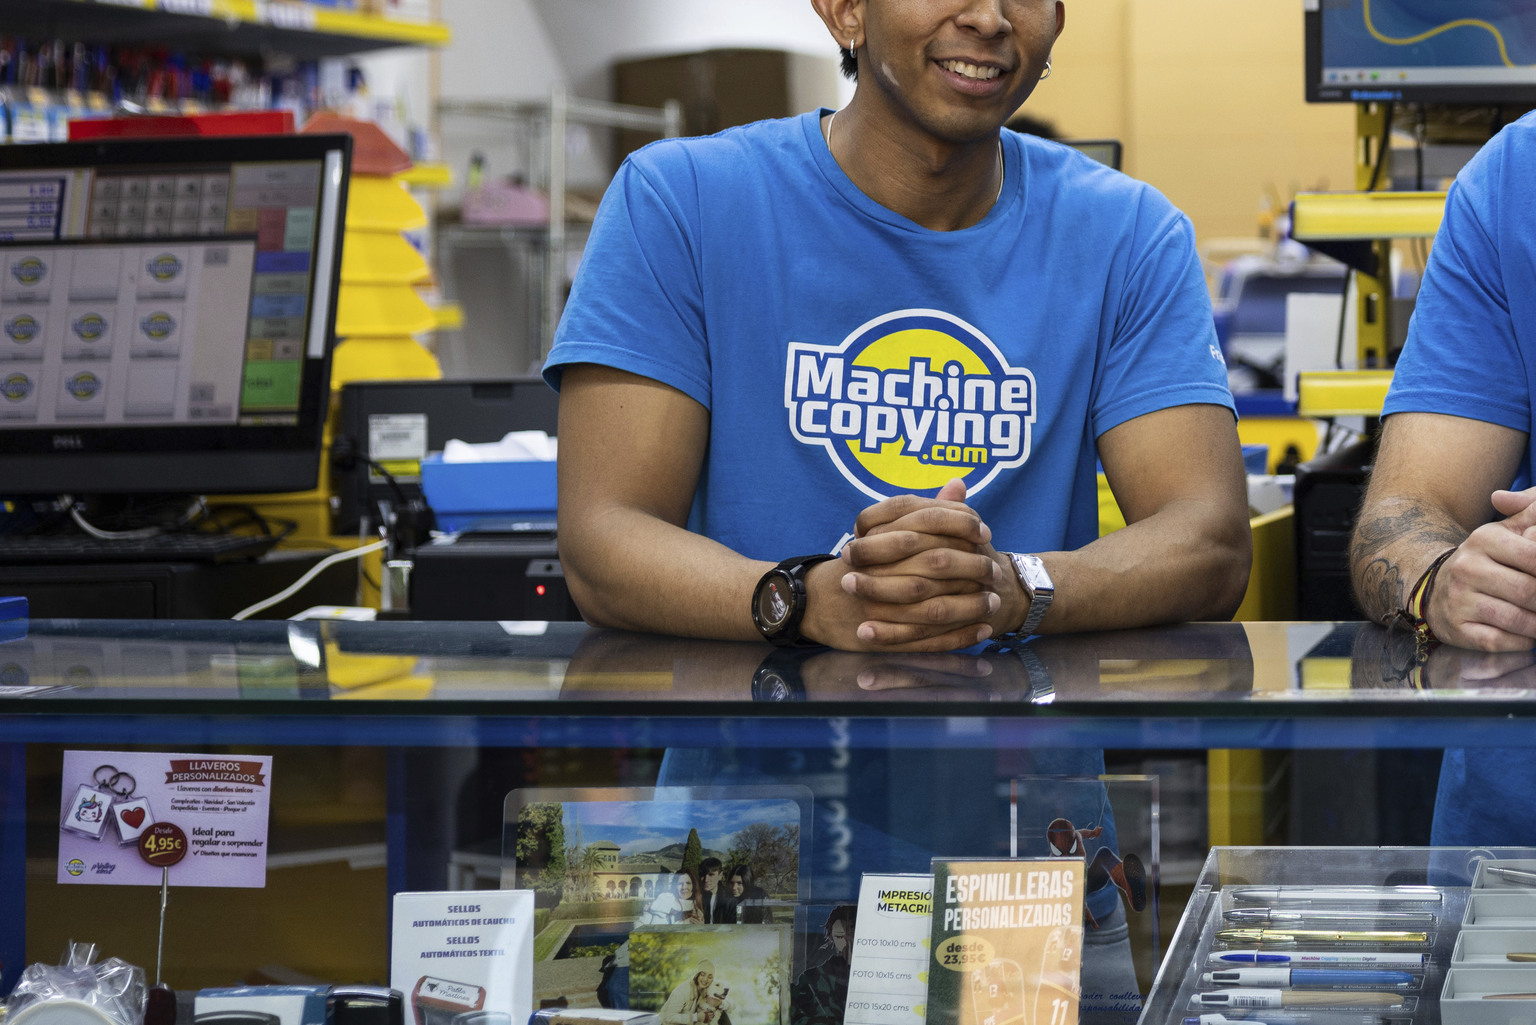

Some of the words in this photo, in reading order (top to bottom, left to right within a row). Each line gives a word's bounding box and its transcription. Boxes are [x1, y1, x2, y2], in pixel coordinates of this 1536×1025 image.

[796, 352, 1028, 412] Machine
[802, 391, 1023, 452] copying
[923, 445, 988, 465] .com
[190, 762, 240, 771] LLAVEROS
[173, 772, 256, 783] PERSONALIZADOS
[193, 828, 213, 836] Ideal
[215, 830, 235, 838] para
[145, 835, 181, 852] 4,95€
[192, 838, 220, 847] regalar
[227, 839, 263, 848] sorprender
[945, 870, 1073, 903] ESPINILLERAS
[448, 905, 481, 913] SELLOS
[944, 903, 1072, 931] PERSONALIZADAS
[412, 918, 470, 927] AUTOMÁTICOS
[446, 936, 480, 944] SELLOS
[857, 938, 878, 946] FOTO
[879, 939, 899, 947] 10x10
[946, 941, 984, 953] desde
[420, 949, 477, 958] AUTOMÁTICOS
[943, 954, 986, 965] 23,95€
[853, 970, 874, 978] FOTO
[876, 971, 894, 979] 10x15
[848, 1002, 870, 1010] FOTO
[872, 1002, 891, 1011] 15x20
[1051, 998, 1069, 1025] 11
